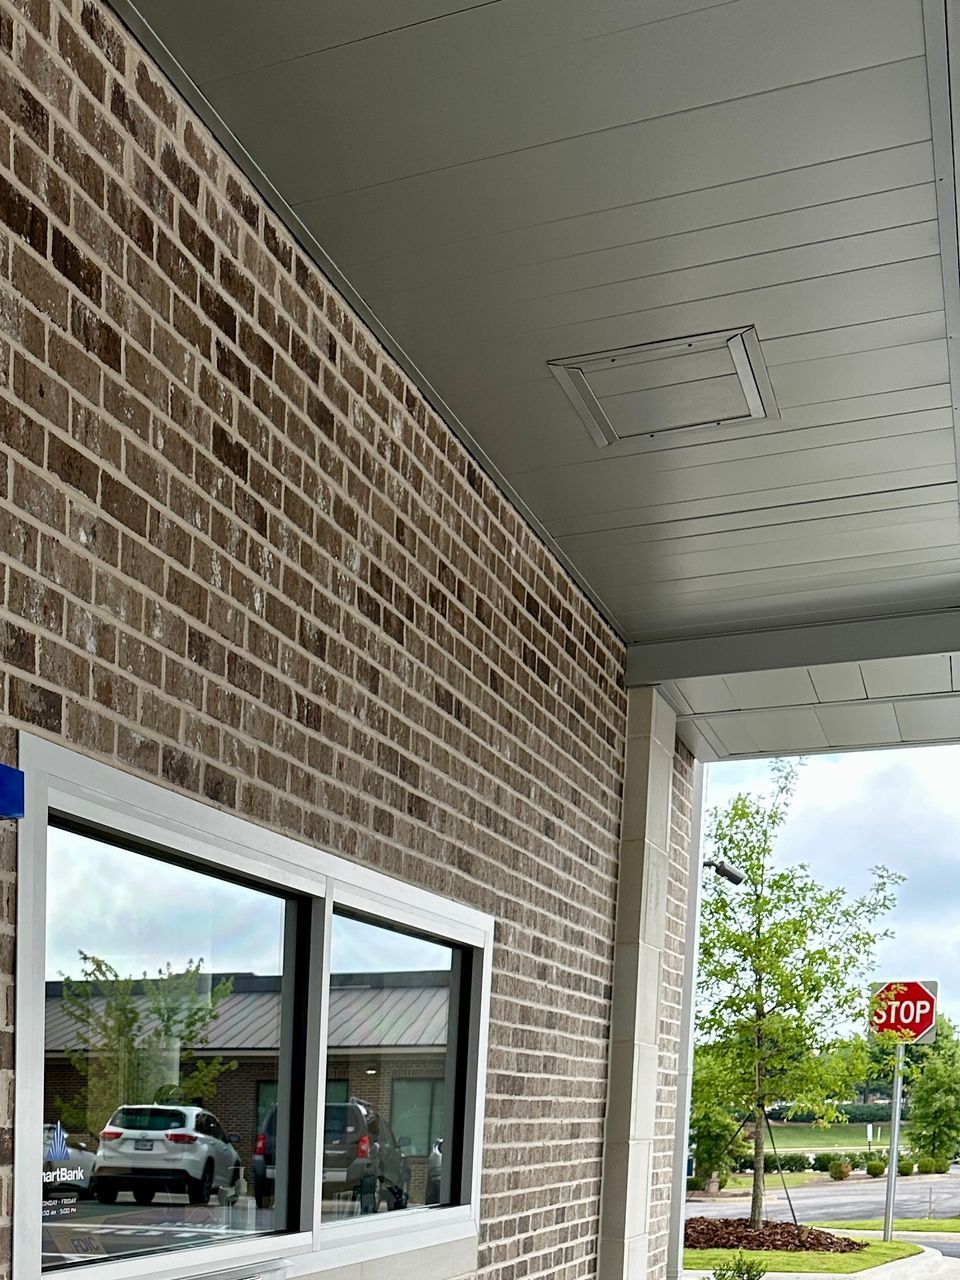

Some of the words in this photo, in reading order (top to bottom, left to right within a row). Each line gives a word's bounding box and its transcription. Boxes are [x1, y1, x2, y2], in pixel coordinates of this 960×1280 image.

[873, 1001, 931, 1024] STOP
[42, 1167, 84, 1182] artBank
[70, 1236, 99, 1254] FDIC
